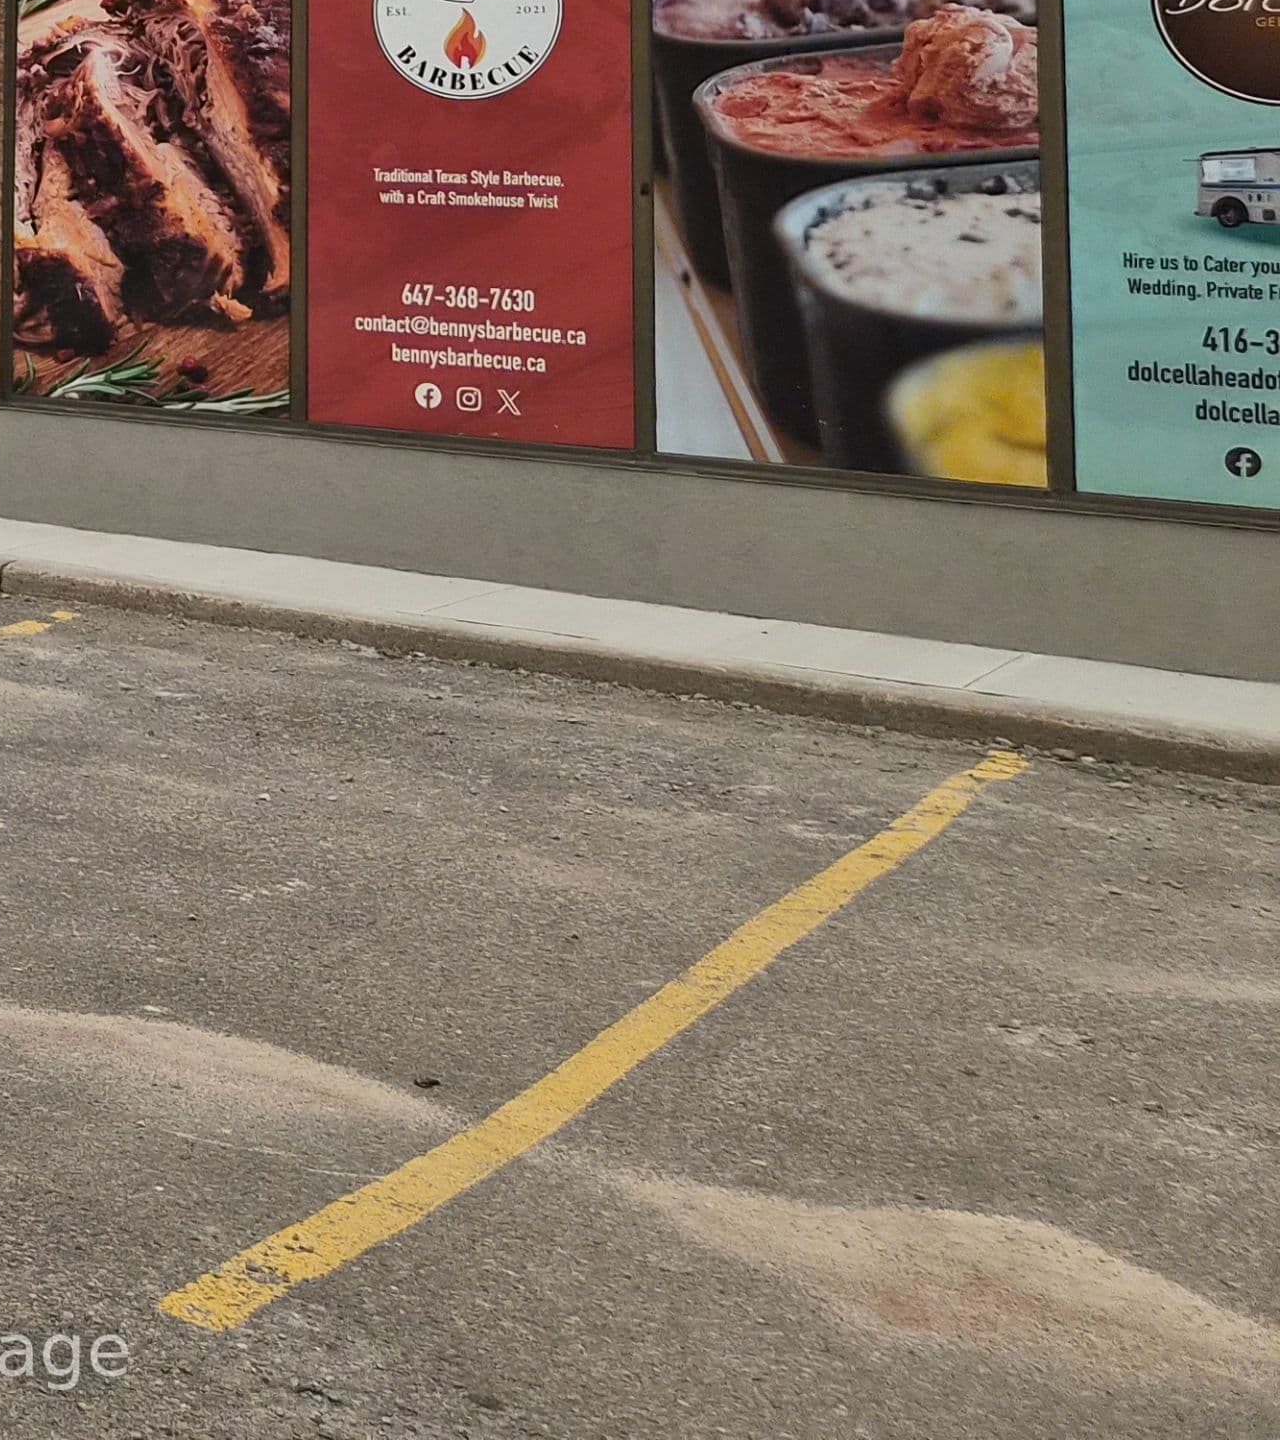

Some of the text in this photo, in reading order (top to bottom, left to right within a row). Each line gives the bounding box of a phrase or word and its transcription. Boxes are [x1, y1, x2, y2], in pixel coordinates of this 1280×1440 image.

[515, 5, 546, 15] 2021
[397, 45, 540, 91] BARBECUE
[373, 167, 433, 184] Traditional
[435, 169, 468, 185] Texas
[470, 170, 500, 188] Style
[379, 190, 559, 209] with a Craft Smokehouse Twist
[1123, 252, 1155, 270] Hire
[1160, 257, 1178, 271] us
[1184, 255, 1199, 271] to
[1204, 255, 1246, 273] Cater
[401, 283, 535, 312] 647-368-7630
[1206, 281, 1264, 300] Private
[355, 314, 586, 345] contact@bennysbarbecue.ca
[392, 343, 547, 372] bennysbarbecue.ca
